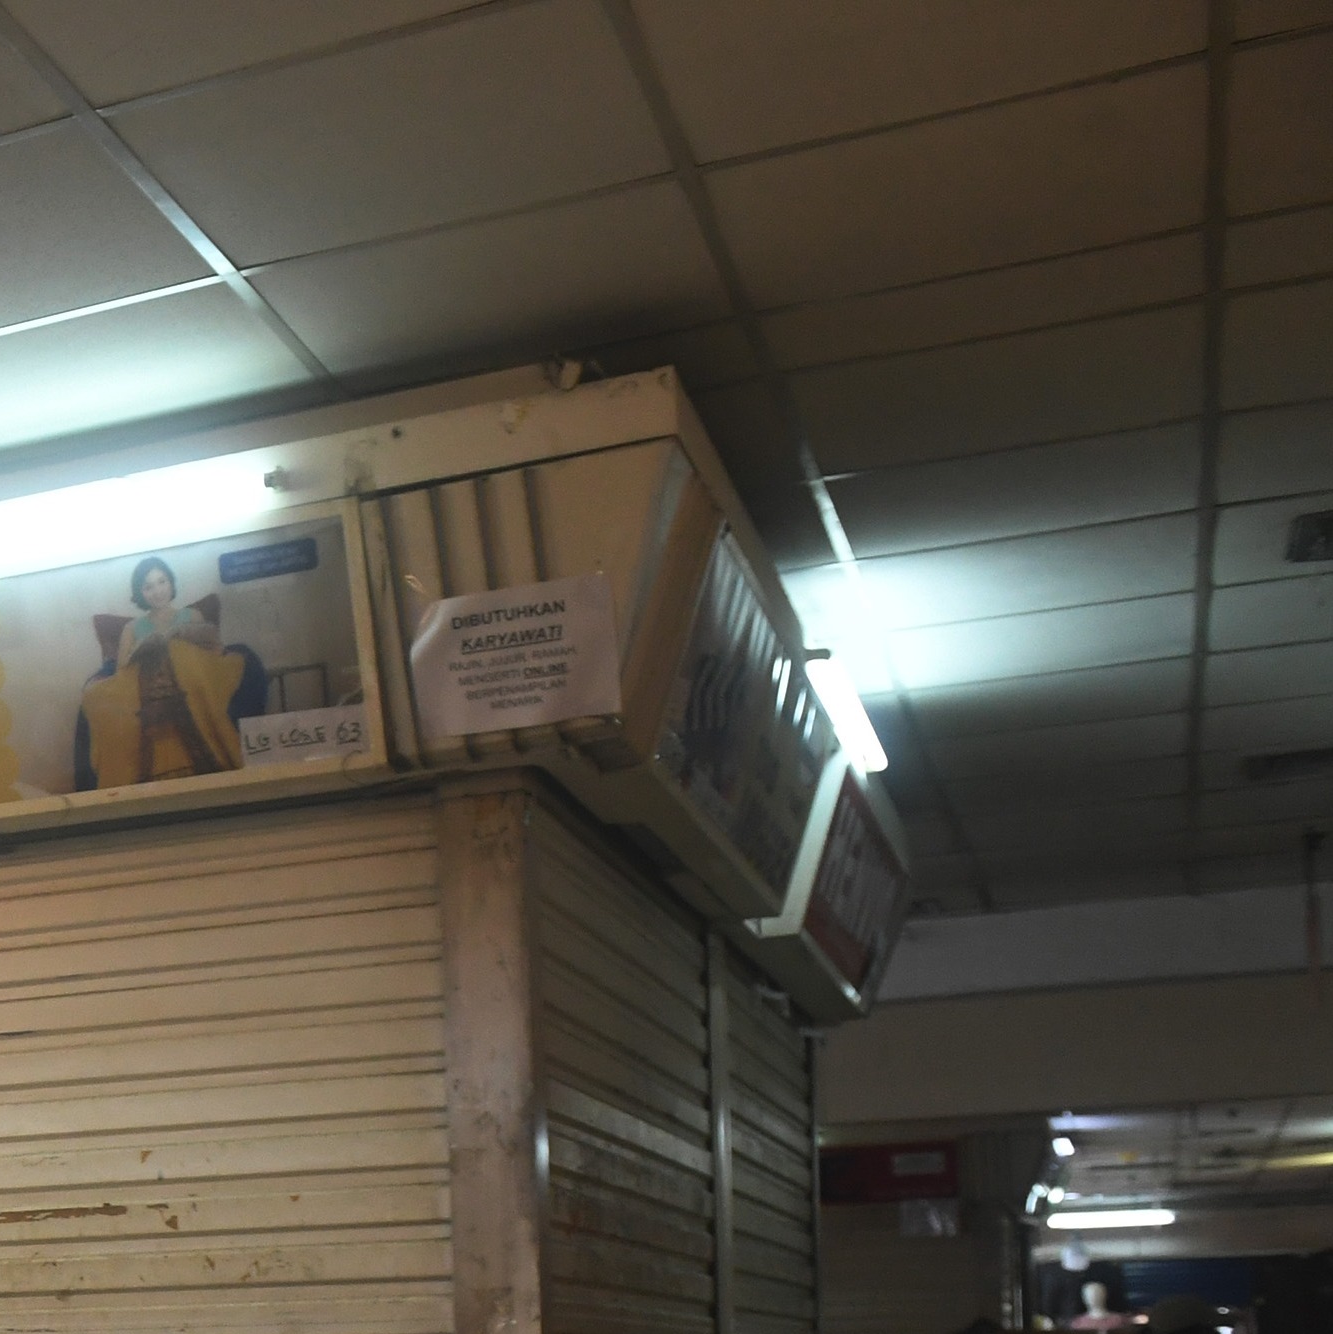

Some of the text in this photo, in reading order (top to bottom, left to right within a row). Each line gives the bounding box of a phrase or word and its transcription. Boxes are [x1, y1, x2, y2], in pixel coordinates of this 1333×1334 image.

[450, 600, 566, 630] DIBUTUHKAN
[461, 624, 564, 652] KARYAWATI
[523, 662, 568, 678] ONLINE
[244, 734, 271, 751] LG
[337, 721, 362, 742] 63
